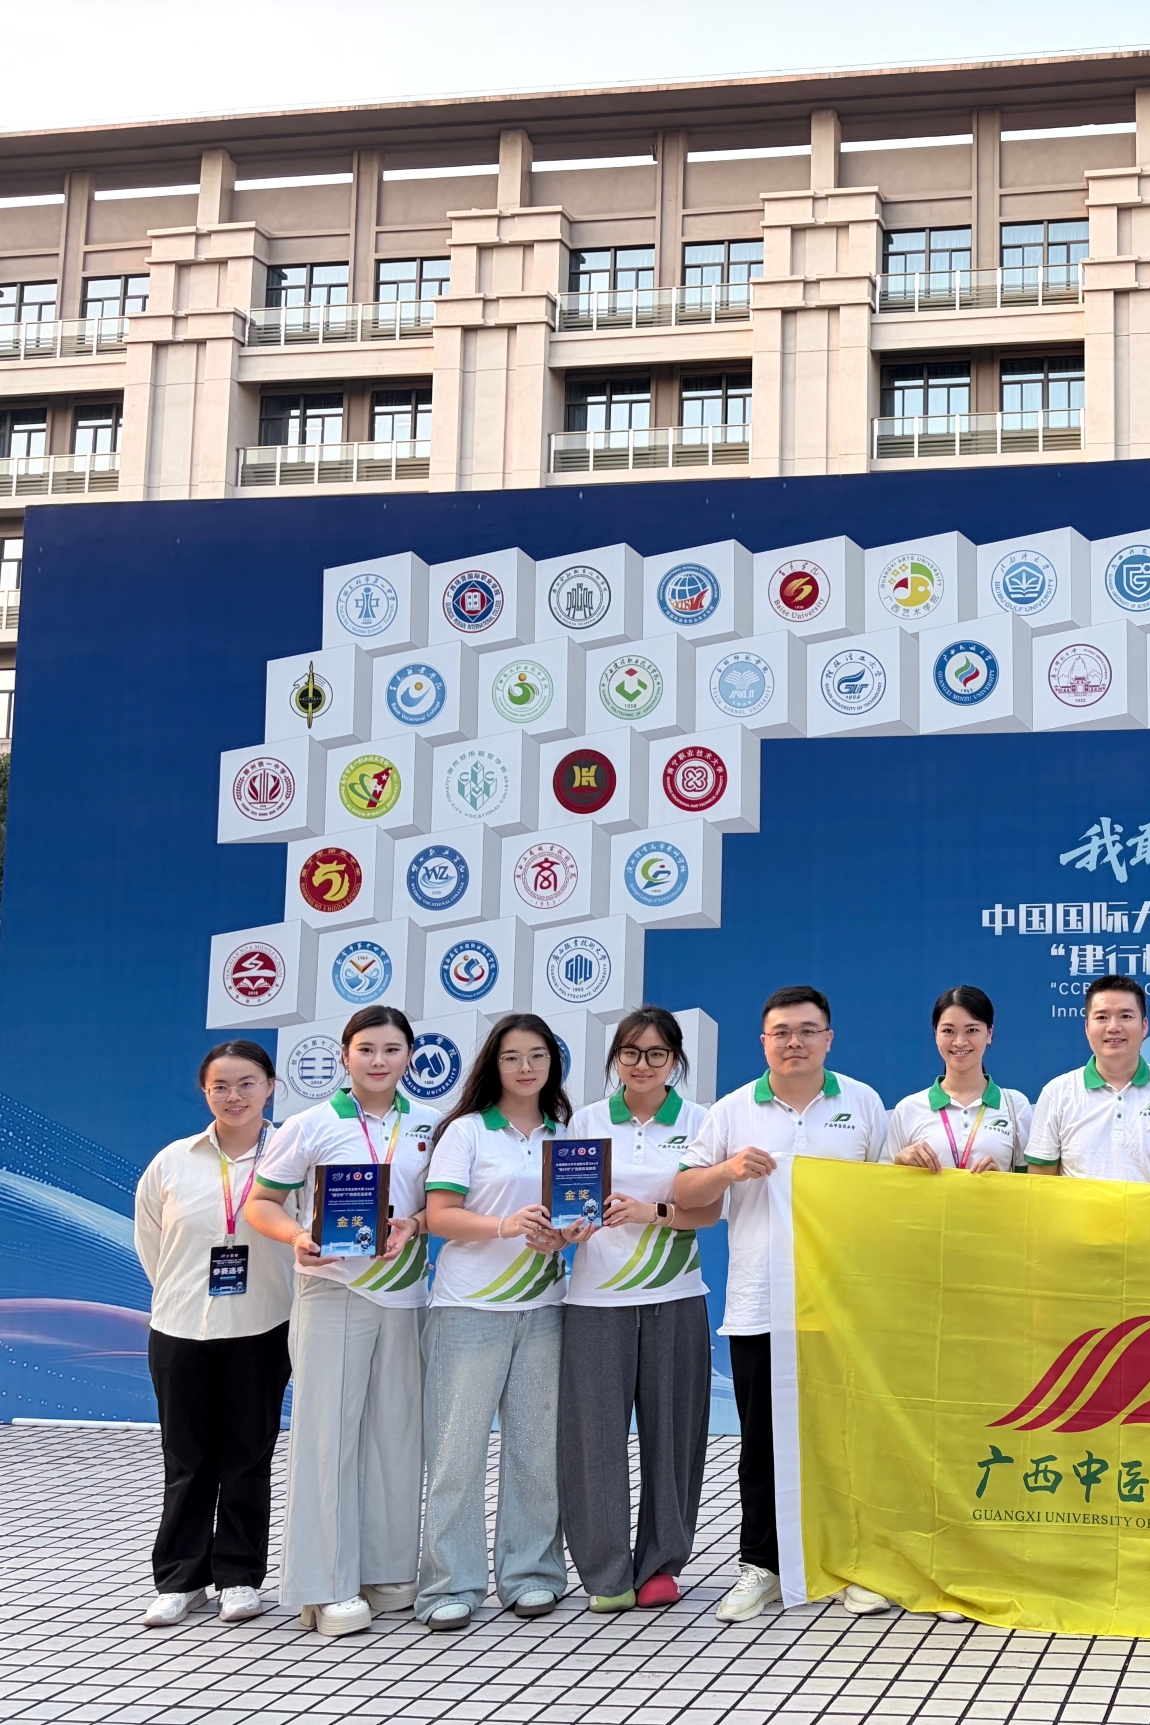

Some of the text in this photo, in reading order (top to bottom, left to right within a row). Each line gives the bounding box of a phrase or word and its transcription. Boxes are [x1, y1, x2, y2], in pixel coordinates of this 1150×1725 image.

[881, 561, 897, 588] GUANGXI
[917, 556, 942, 587] UNIVERSITY
[774, 597, 825, 619] Baise University
[883, 594, 940, 617] 广西艺术学院
[995, 579, 1054, 612] BEIBU GULF UNIVERSITY
[831, 697, 856, 711] UNIVERSITY
[863, 681, 883, 708] TECHNOLOGY
[937, 669, 995, 702] GUANGXI MINZU UNIVERSITY
[401, 713, 426, 722] Vocational
[426, 701, 441, 718] College
[724, 705, 746, 715] NORMAL
[748, 685, 772, 713] UNIVERSITY
[243, 761, 286, 775] 柳州铁一中学
[667, 749, 724, 775] 南宁职业技术大学
[451, 803, 463, 815] CITY
[464, 803, 501, 819] VOCATIONAL
[499, 776, 509, 804] COLLEGE
[422, 898, 451, 907] VOCATIONAL
[450, 882, 465, 901] COLLEGE
[336, 943, 390, 965] 南宁市第十四中学
[551, 963, 606, 999] GUANGXI POLYTECHNIC UNIVERSITY
[426, 1067, 457, 1095] UNIVERSITY
[564, 1188, 589, 1201] 金奖
[337, 1215, 364, 1228] 金奖
[972, 1508, 1041, 1523] GUANGXI
[1045, 1511, 1132, 1528] UNIVERSITY
